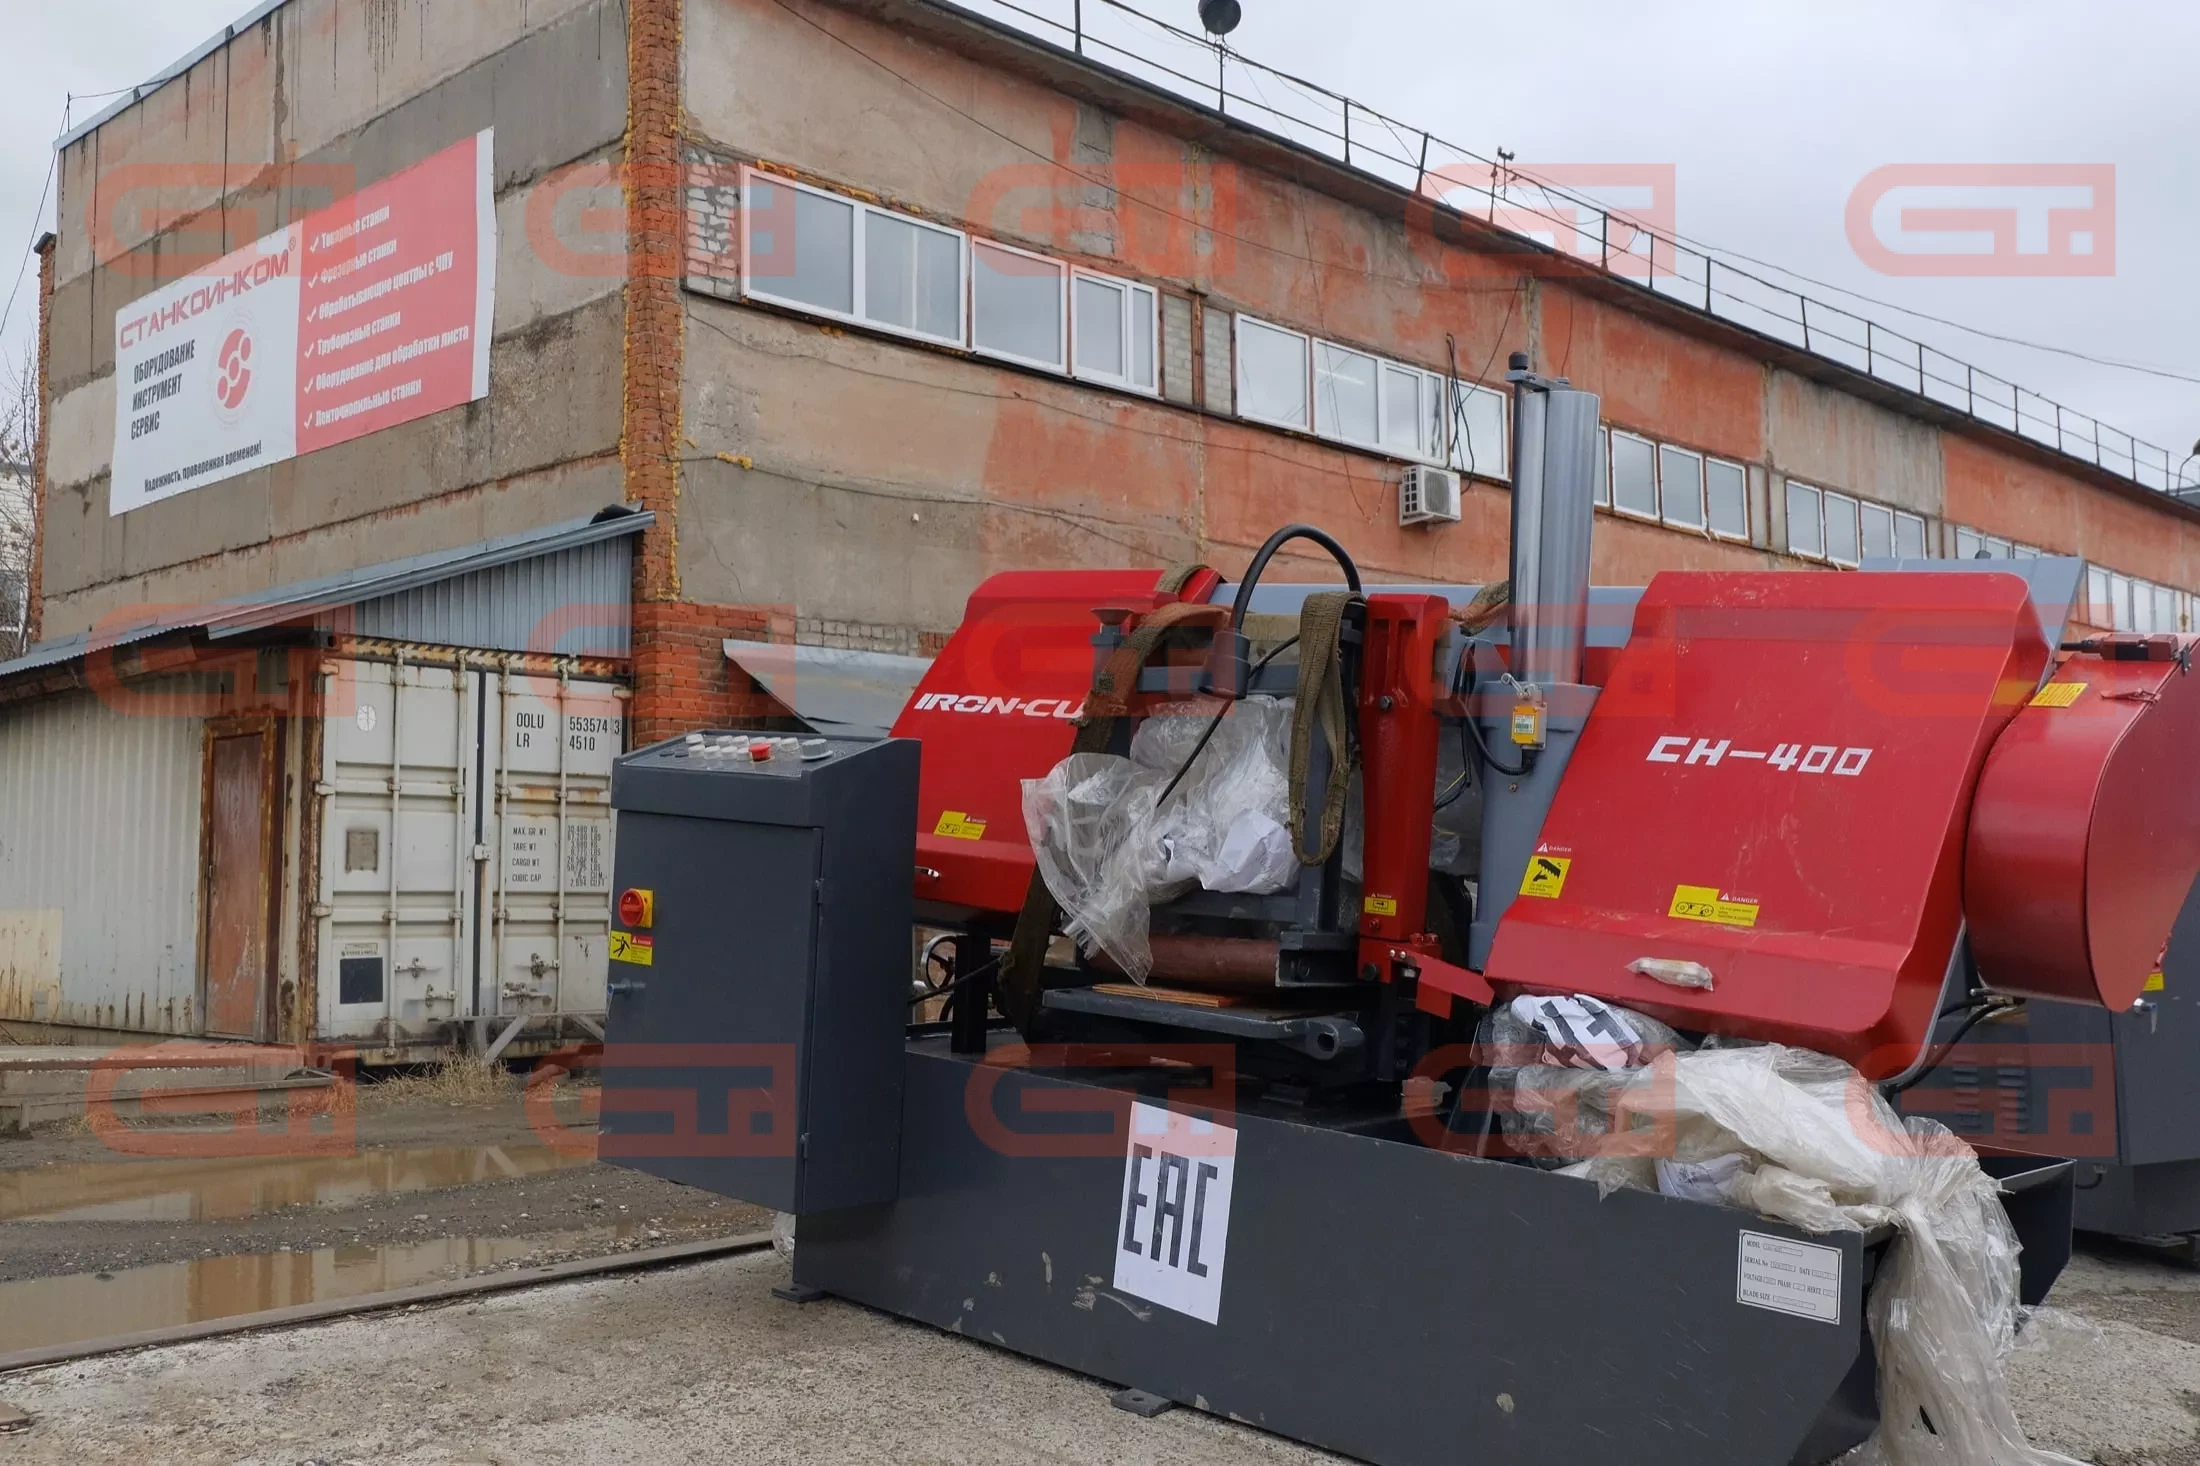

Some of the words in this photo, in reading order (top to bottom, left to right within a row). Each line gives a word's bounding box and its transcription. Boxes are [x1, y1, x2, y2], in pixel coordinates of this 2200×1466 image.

[361, 205, 389, 231] станки
[368, 239, 397, 263] станки
[393, 264, 427, 290] центры
[436, 251, 453, 272] ЧПУ
[120, 249, 288, 349] СТАНКОИНКОМ
[372, 312, 401, 336] станки
[134, 339, 195, 384] ОБОРУДОВАНИЕ
[316, 358, 374, 391] Оборудование
[375, 351, 391, 373] для
[392, 335, 440, 364] обработки
[441, 325, 469, 348] листа
[132, 373, 182, 412] ИНСТРУМЕНТ
[391, 378, 421, 402] станки
[131, 410, 160, 440] СЕРВИС
[182, 456, 225, 480] проверенная
[225, 440, 262, 467] временем!
[913, 693, 1084, 719] IRON-CU
[569, 716, 608, 734] 553574
[614, 719, 620, 735] 3
[516, 732, 530, 748] LR
[569, 735, 595, 751] 4510
[1123, 1142, 1218, 1278] EAC
[1746, 1239, 1761, 1249] MODEL
[1744, 1255, 1761, 1266] SERIAL
[1799, 1267, 1811, 1276] DATE
[1743, 1272, 1763, 1282] VOLTAGE
[1777, 1279, 1792, 1288] PHASE
[1742, 1289, 1760, 1299] BLADE
[1759, 1291, 1771, 1301] SIZE
